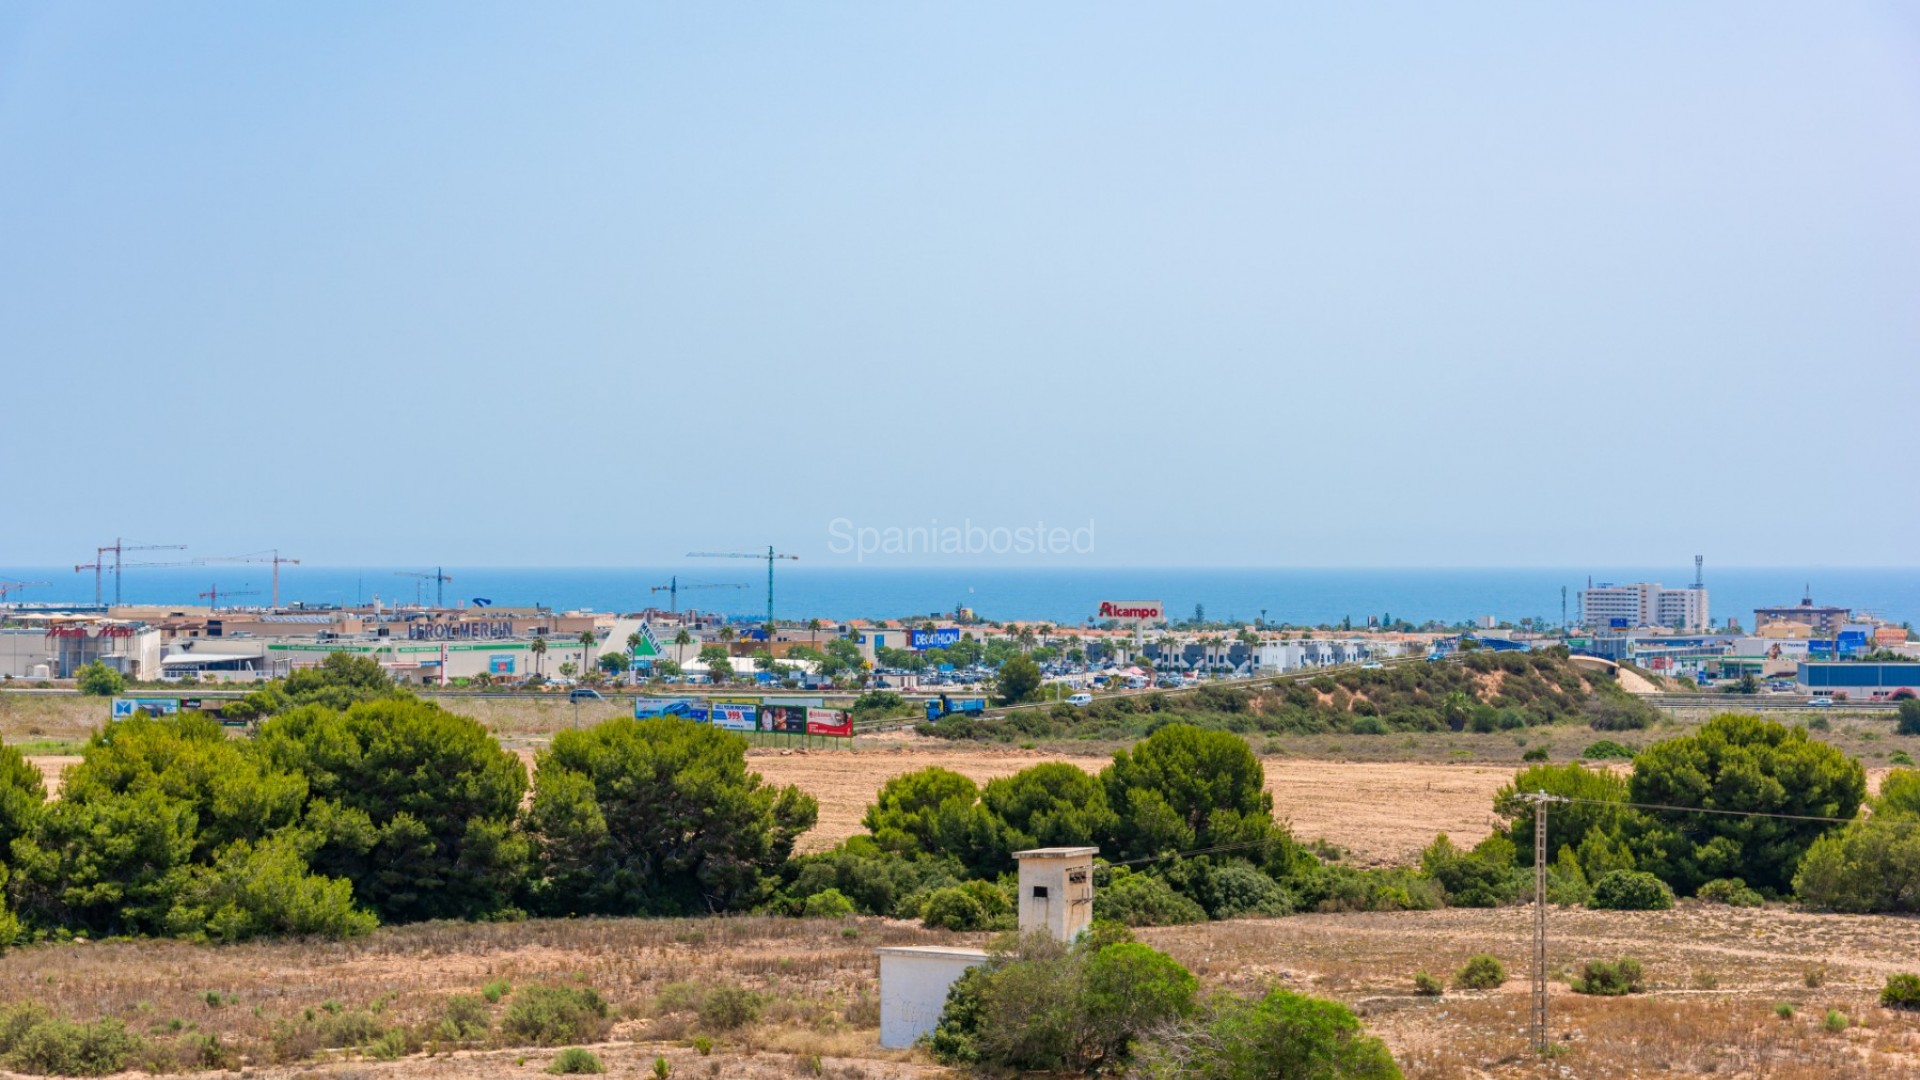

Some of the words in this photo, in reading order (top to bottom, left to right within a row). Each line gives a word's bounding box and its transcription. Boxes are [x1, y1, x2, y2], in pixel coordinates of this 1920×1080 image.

[1099, 602, 1158, 619] Alcampo
[408, 623, 453, 640] LEROY
[459, 621, 512, 640] MERLIN
[641, 622, 662, 655] MERLIN
[915, 632, 958, 646] DECATHLON
